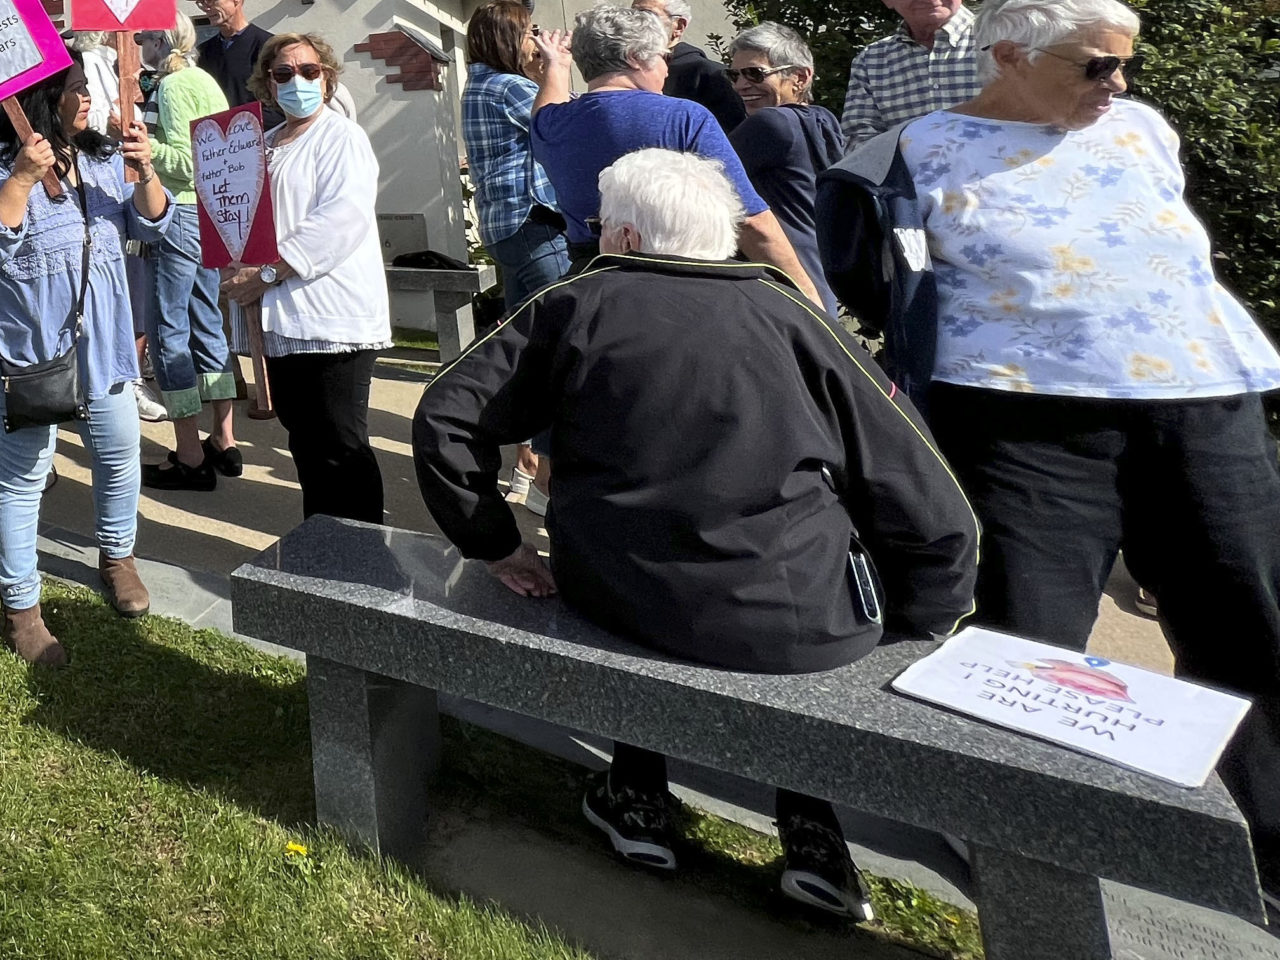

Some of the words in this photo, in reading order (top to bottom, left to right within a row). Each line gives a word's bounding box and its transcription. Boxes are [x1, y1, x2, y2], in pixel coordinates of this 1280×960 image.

[196, 131, 216, 147] We
[202, 147, 227, 162] Father
[227, 161, 245, 174] Bob
[212, 178, 231, 195] Let
[215, 192, 250, 208] Them
[959, 661, 1035, 686] HELP
[976, 690, 1043, 713] ARE
[983, 678, 1137, 732] HURTING
[1043, 683, 1165, 727] PLEASE
[1057, 715, 1115, 742] WE
